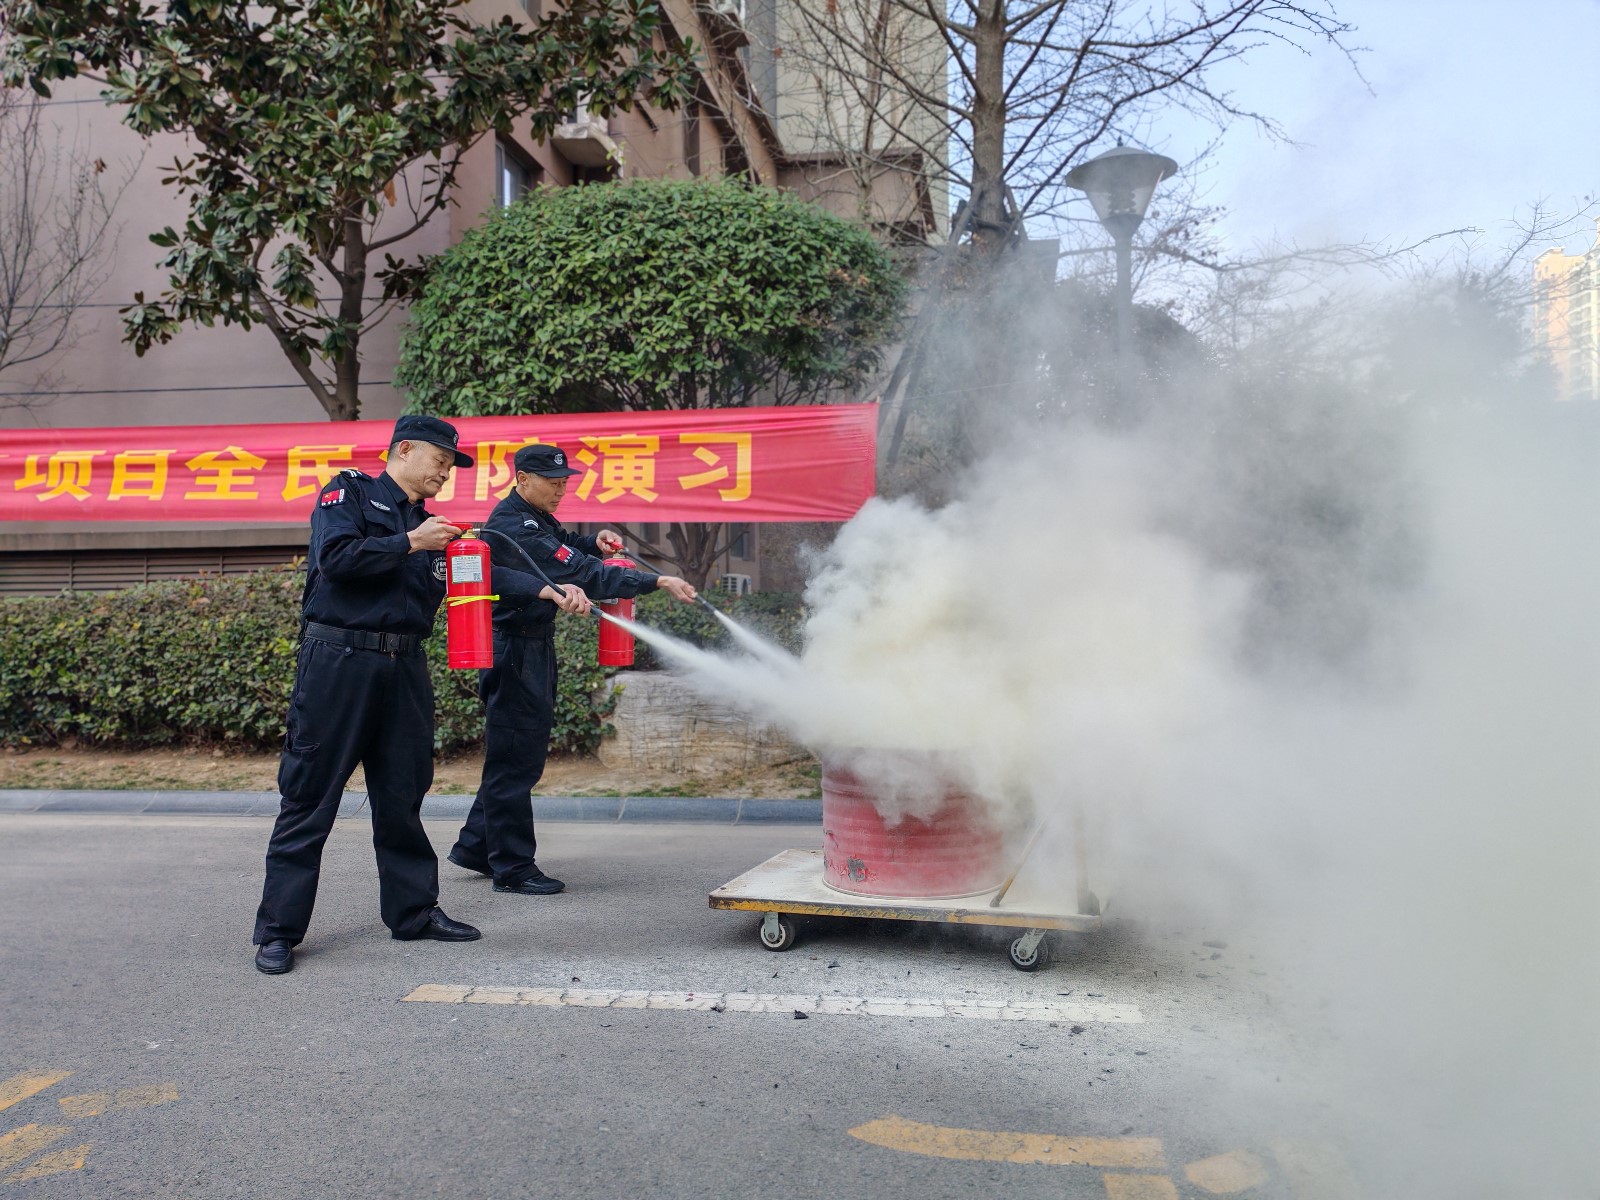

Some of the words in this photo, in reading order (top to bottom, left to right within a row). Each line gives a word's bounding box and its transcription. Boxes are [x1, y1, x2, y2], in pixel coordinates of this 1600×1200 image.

[0, 433, 752, 504] 项目全民防演习
